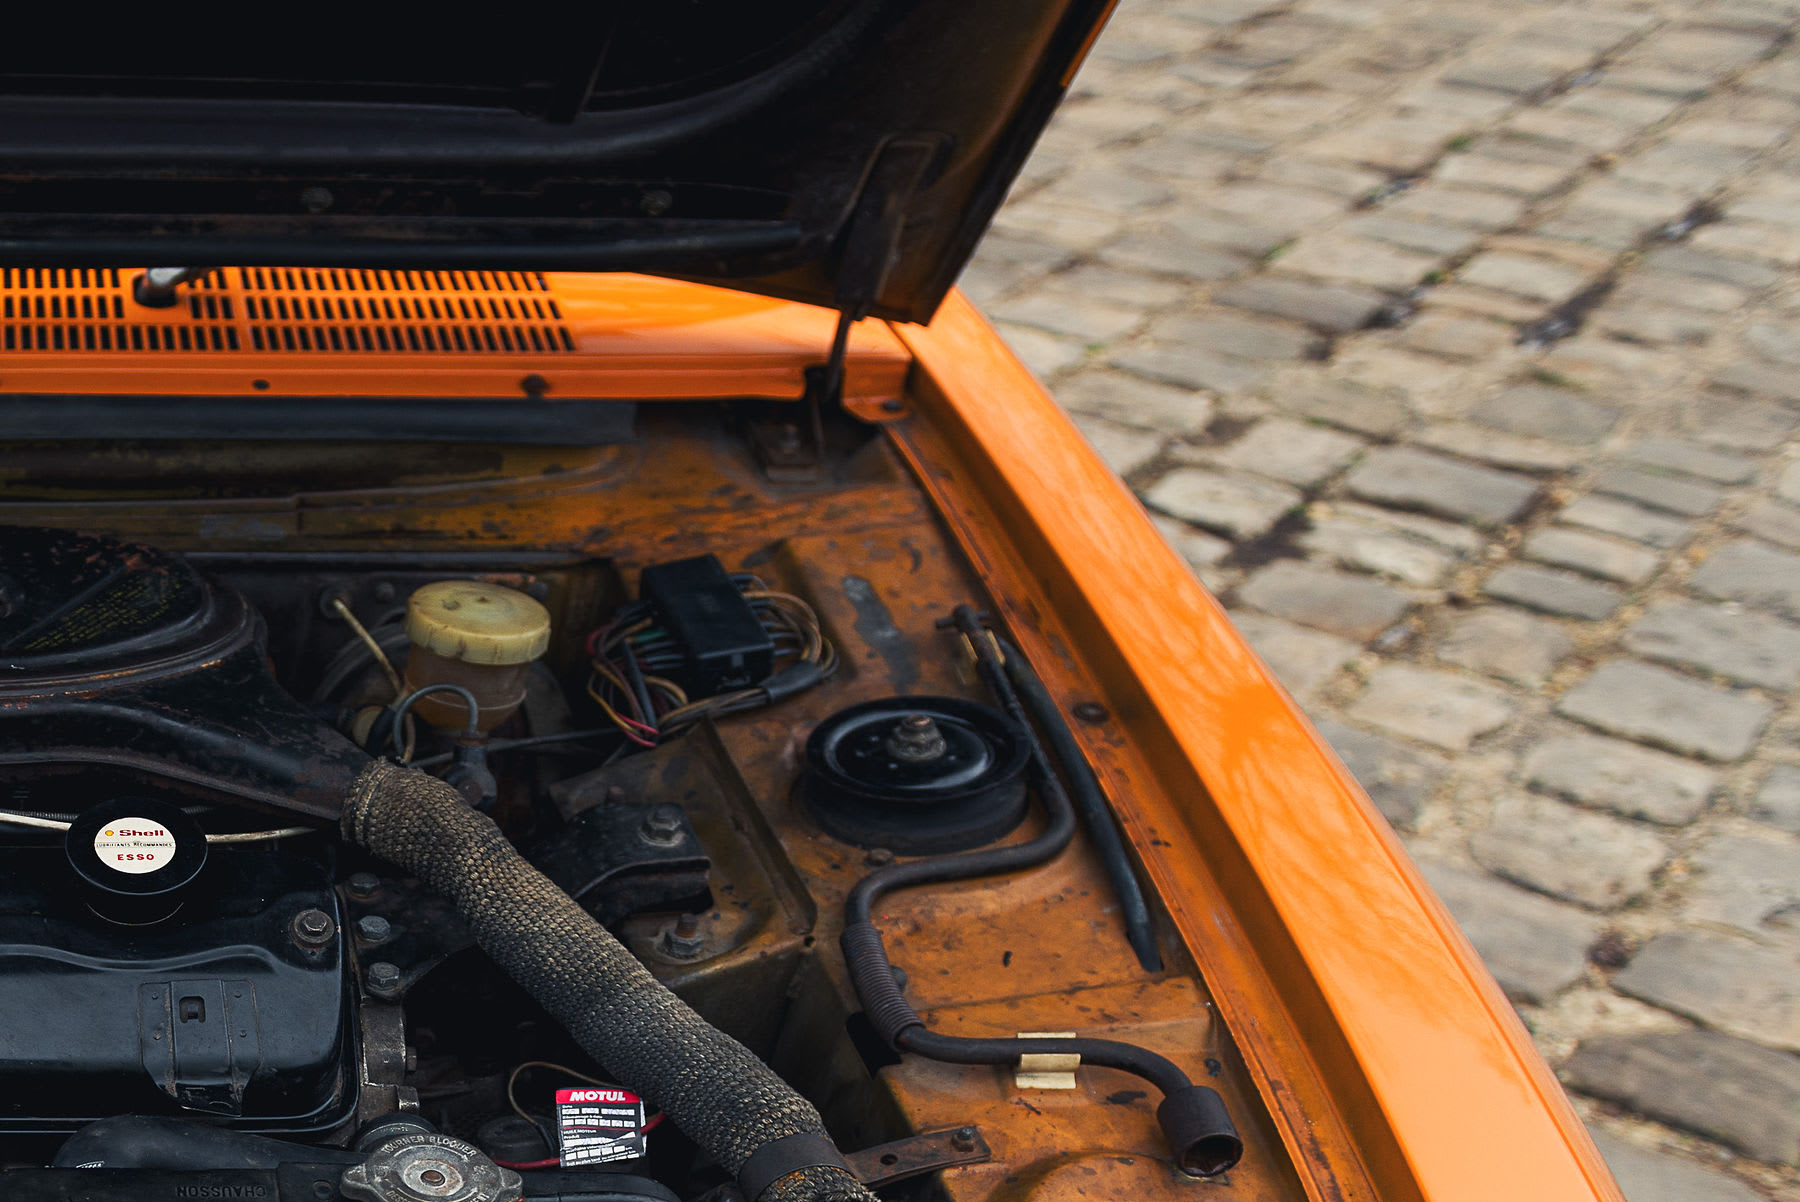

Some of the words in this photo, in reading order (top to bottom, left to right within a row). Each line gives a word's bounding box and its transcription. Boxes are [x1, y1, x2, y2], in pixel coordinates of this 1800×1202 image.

[570, 1091, 626, 1102] MOTUL
[381, 1135, 425, 1154] TOURNER
[429, 1136, 477, 1158] BLOQUER
[176, 1184, 266, 1198] CHAUSSON
